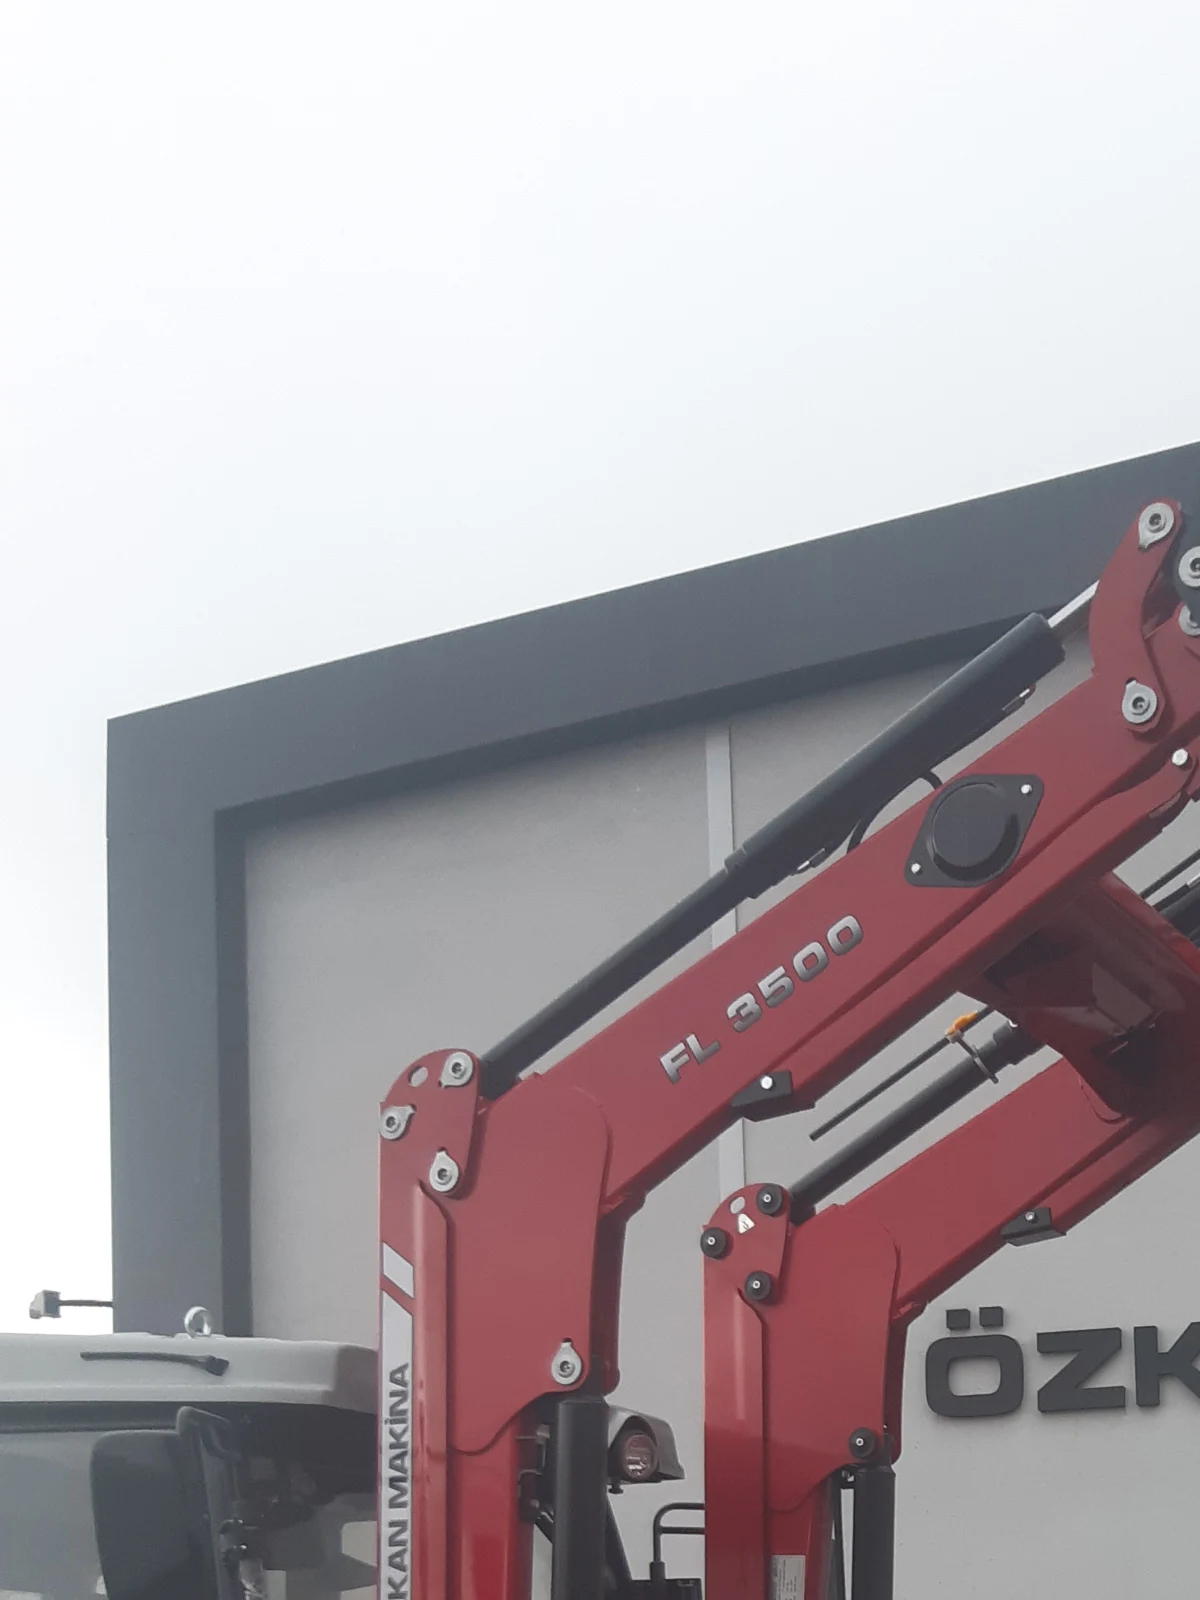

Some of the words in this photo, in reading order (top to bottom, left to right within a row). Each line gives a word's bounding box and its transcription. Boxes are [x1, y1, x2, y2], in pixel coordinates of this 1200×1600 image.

[659, 1033, 721, 1085] FL
[726, 915, 863, 1033] 3500
[385, 1362, 409, 1509] MAKİNA
